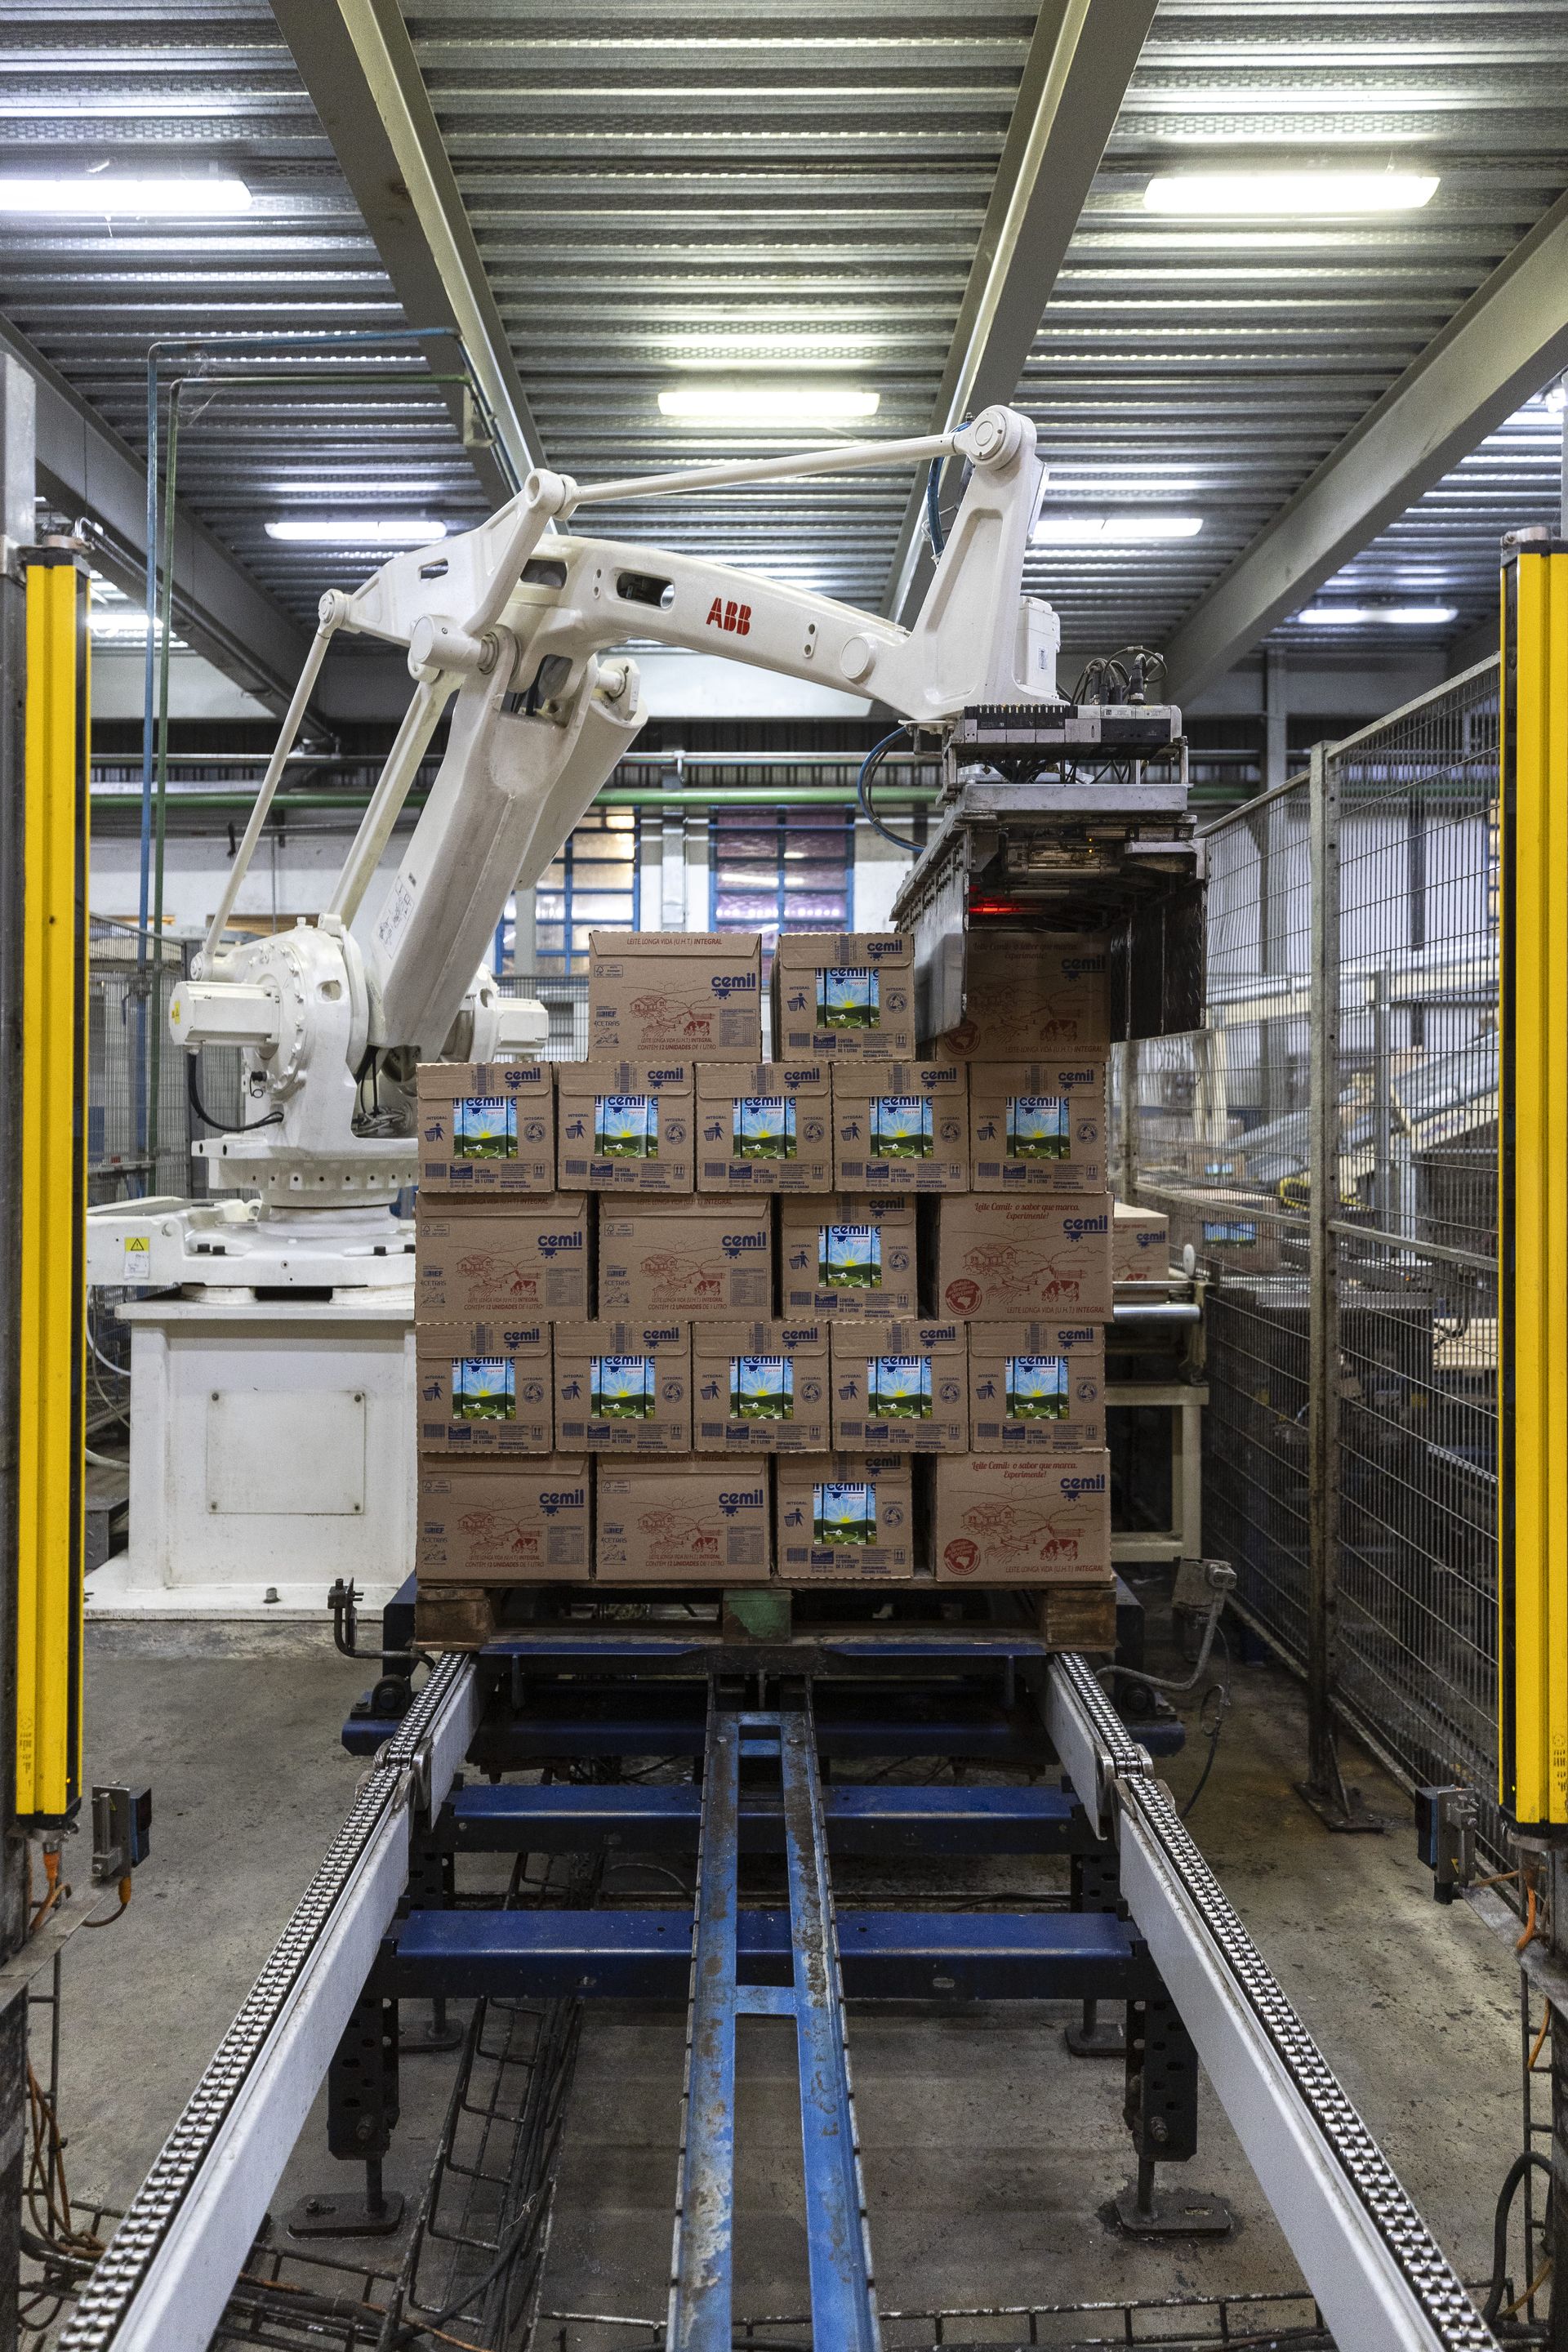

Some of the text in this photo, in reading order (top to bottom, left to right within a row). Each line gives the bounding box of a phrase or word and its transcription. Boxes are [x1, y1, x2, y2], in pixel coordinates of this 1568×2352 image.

[706, 597, 751, 635] ABB
[867, 939, 902, 951] cemil
[1062, 955, 1106, 969] cemil
[830, 967, 867, 977] cemil
[711, 973, 755, 987] cemil
[505, 1067, 541, 1080] cemil
[648, 1067, 683, 1080] cemil
[785, 1067, 819, 1080] cemil
[921, 1067, 956, 1080] cemil
[1058, 1070, 1094, 1082] cemil
[466, 1097, 504, 1107] cemil
[608, 1095, 645, 1106] cemil
[745, 1096, 782, 1106] cemil
[882, 1096, 920, 1106] cemil
[1019, 1096, 1057, 1106] cemil
[870, 1198, 905, 1209] cemil
[975, 1202, 990, 1213] Leite
[991, 1203, 1013, 1211] Cemil:
[1041, 1205, 1054, 1213] que
[1006, 1212, 1049, 1220] Experimente!
[1063, 1215, 1107, 1230] cemil
[832, 1225, 869, 1235] cemil
[538, 1232, 582, 1246] cemil
[722, 1232, 766, 1246] cemil
[1137, 1231, 1165, 1241] cemil
[504, 1328, 539, 1340] cemil
[644, 1327, 679, 1339] cemil
[782, 1328, 817, 1339] cemil
[920, 1326, 956, 1339] cemil
[1058, 1328, 1094, 1339] cemil
[604, 1356, 642, 1365] cemil
[743, 1356, 780, 1364] cemil
[881, 1356, 919, 1365] cemil
[1018, 1356, 1056, 1365] cemil
[866, 1455, 901, 1468] cemil
[972, 1461, 987, 1472] Leite
[988, 1461, 1010, 1470] Cemil:
[1039, 1463, 1051, 1472] que
[1004, 1471, 1047, 1480] Experimente!
[826, 1483, 864, 1491] cemil
[1061, 1474, 1105, 1490] cemil
[540, 1490, 584, 1504] cemil
[719, 1490, 764, 1504] cemil
